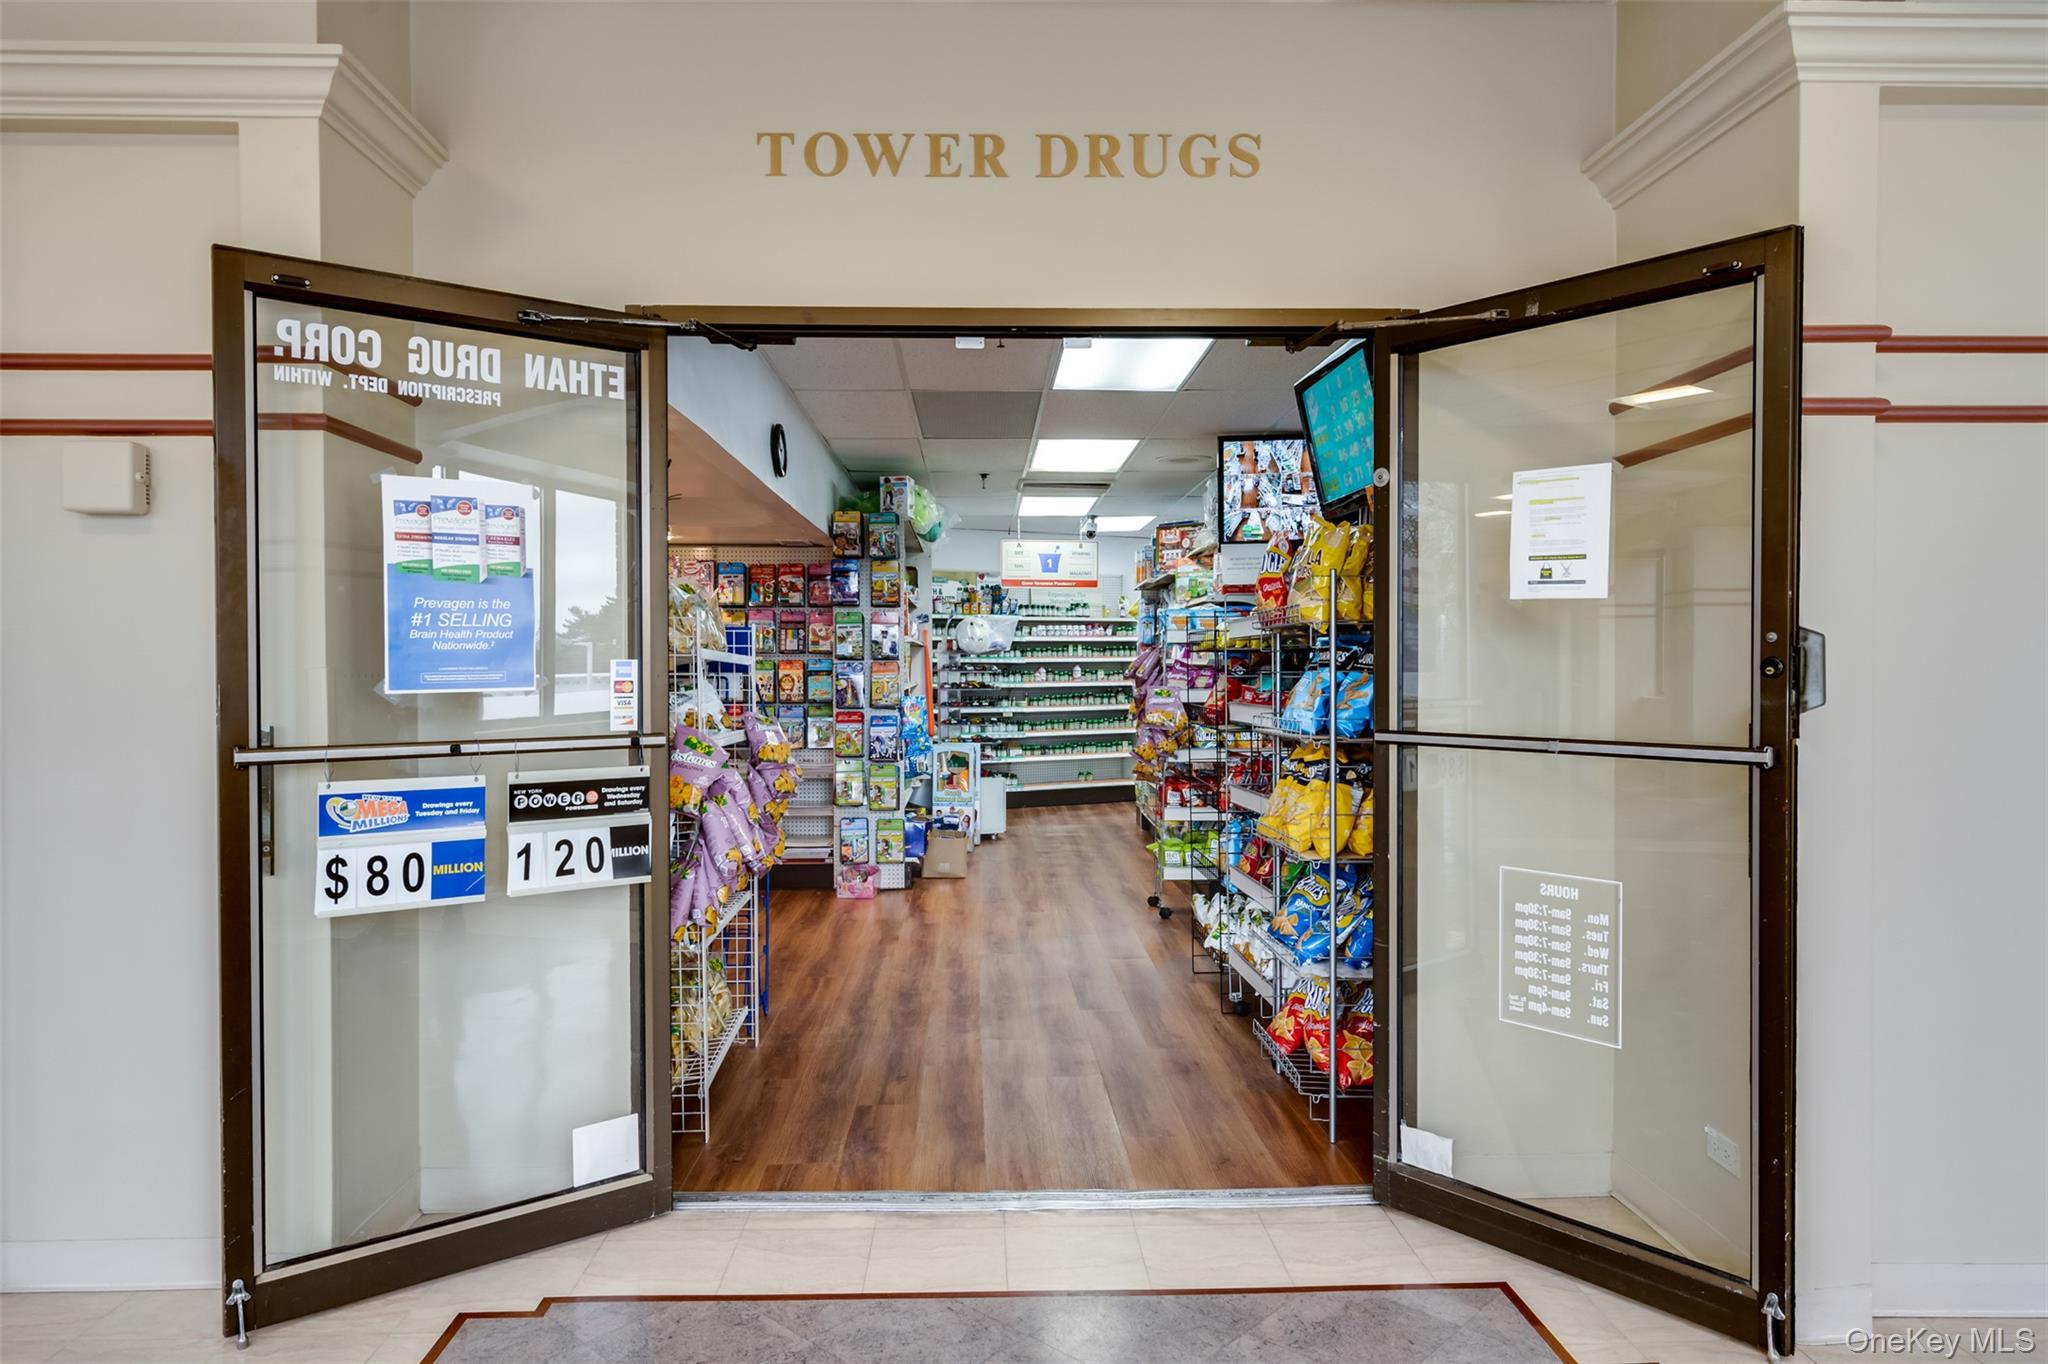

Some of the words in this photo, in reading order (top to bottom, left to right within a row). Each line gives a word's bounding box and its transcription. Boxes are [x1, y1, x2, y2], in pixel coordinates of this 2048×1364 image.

[756, 132, 1009, 178] TOWER
[1034, 132, 1262, 178] DRUGS
[1046, 558, 1052, 568] 1
[414, 597, 474, 611] Prevagen
[479, 598, 488, 609] is
[492, 598, 511, 609] the
[411, 612, 431, 627] #1
[438, 612, 512, 628] SELLING
[410, 629, 437, 639] Brain
[439, 629, 473, 639] Health
[475, 629, 514, 639] Product
[352, 799, 409, 819] MEGA
[352, 814, 408, 830] MILLIONS
[433, 861, 483, 875] MILLION
